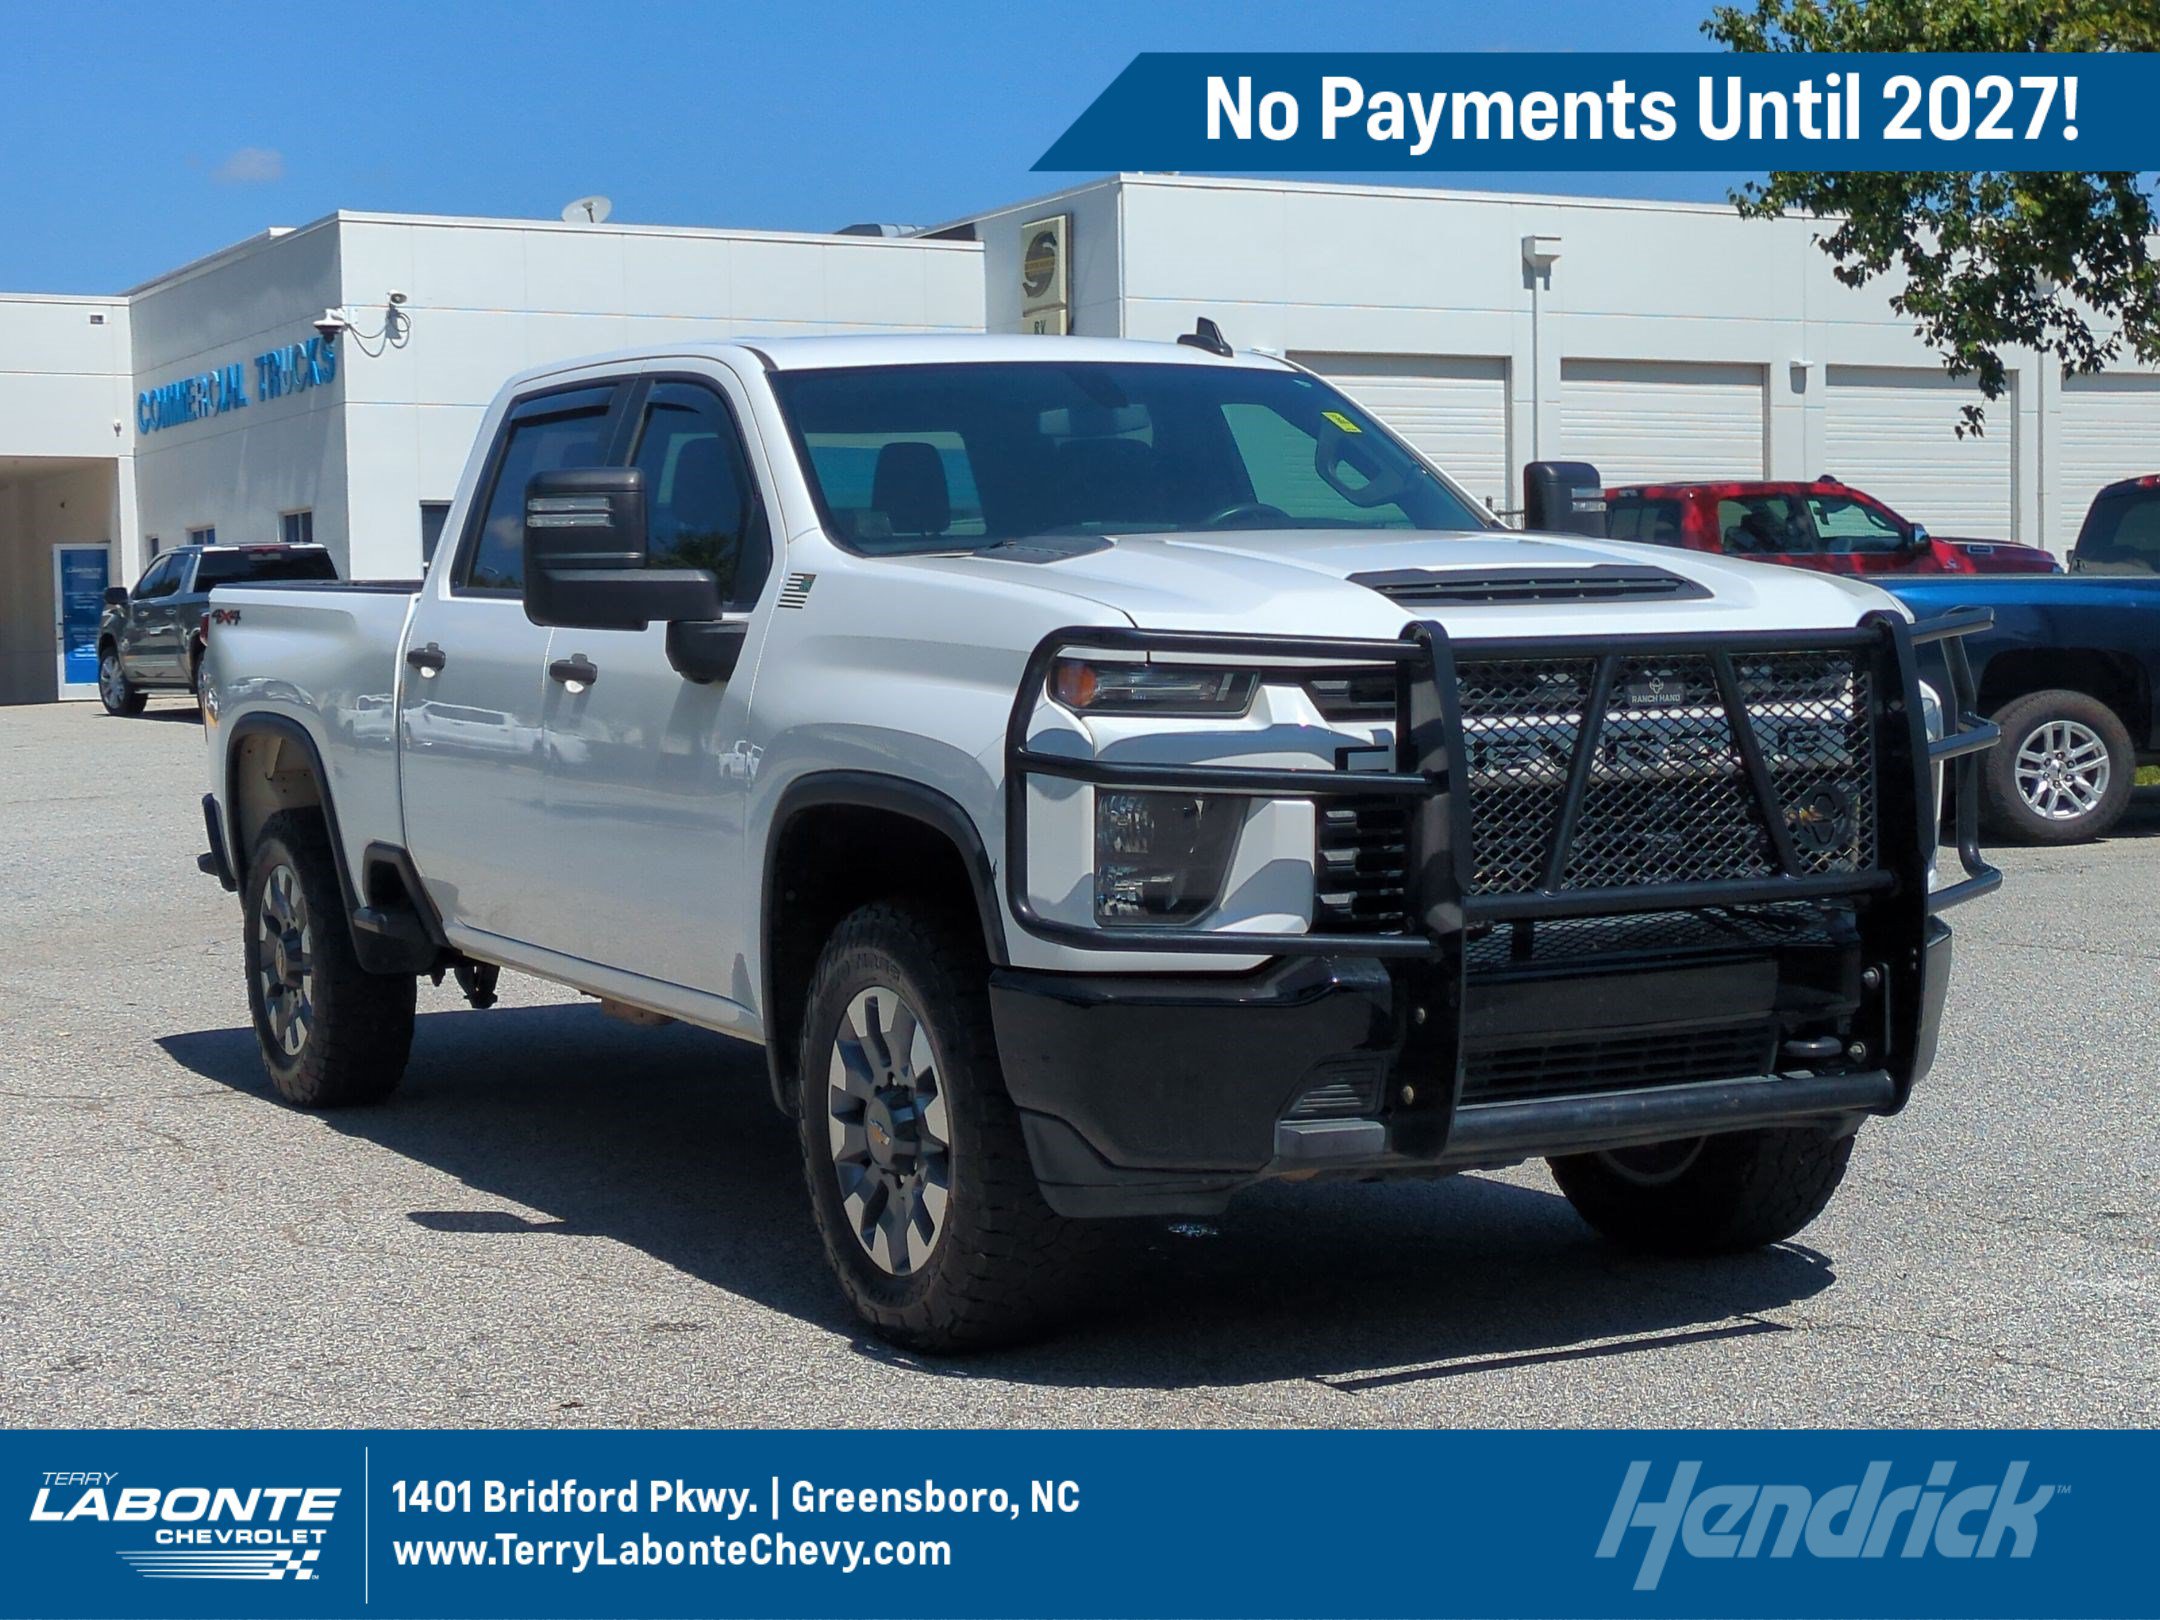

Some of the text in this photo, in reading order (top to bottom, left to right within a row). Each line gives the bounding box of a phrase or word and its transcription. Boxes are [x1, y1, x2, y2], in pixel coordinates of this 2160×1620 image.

[137, 337, 336, 435] COMMERCIAL TRUCKS
[1631, 693, 1681, 704] RANCH HAND
